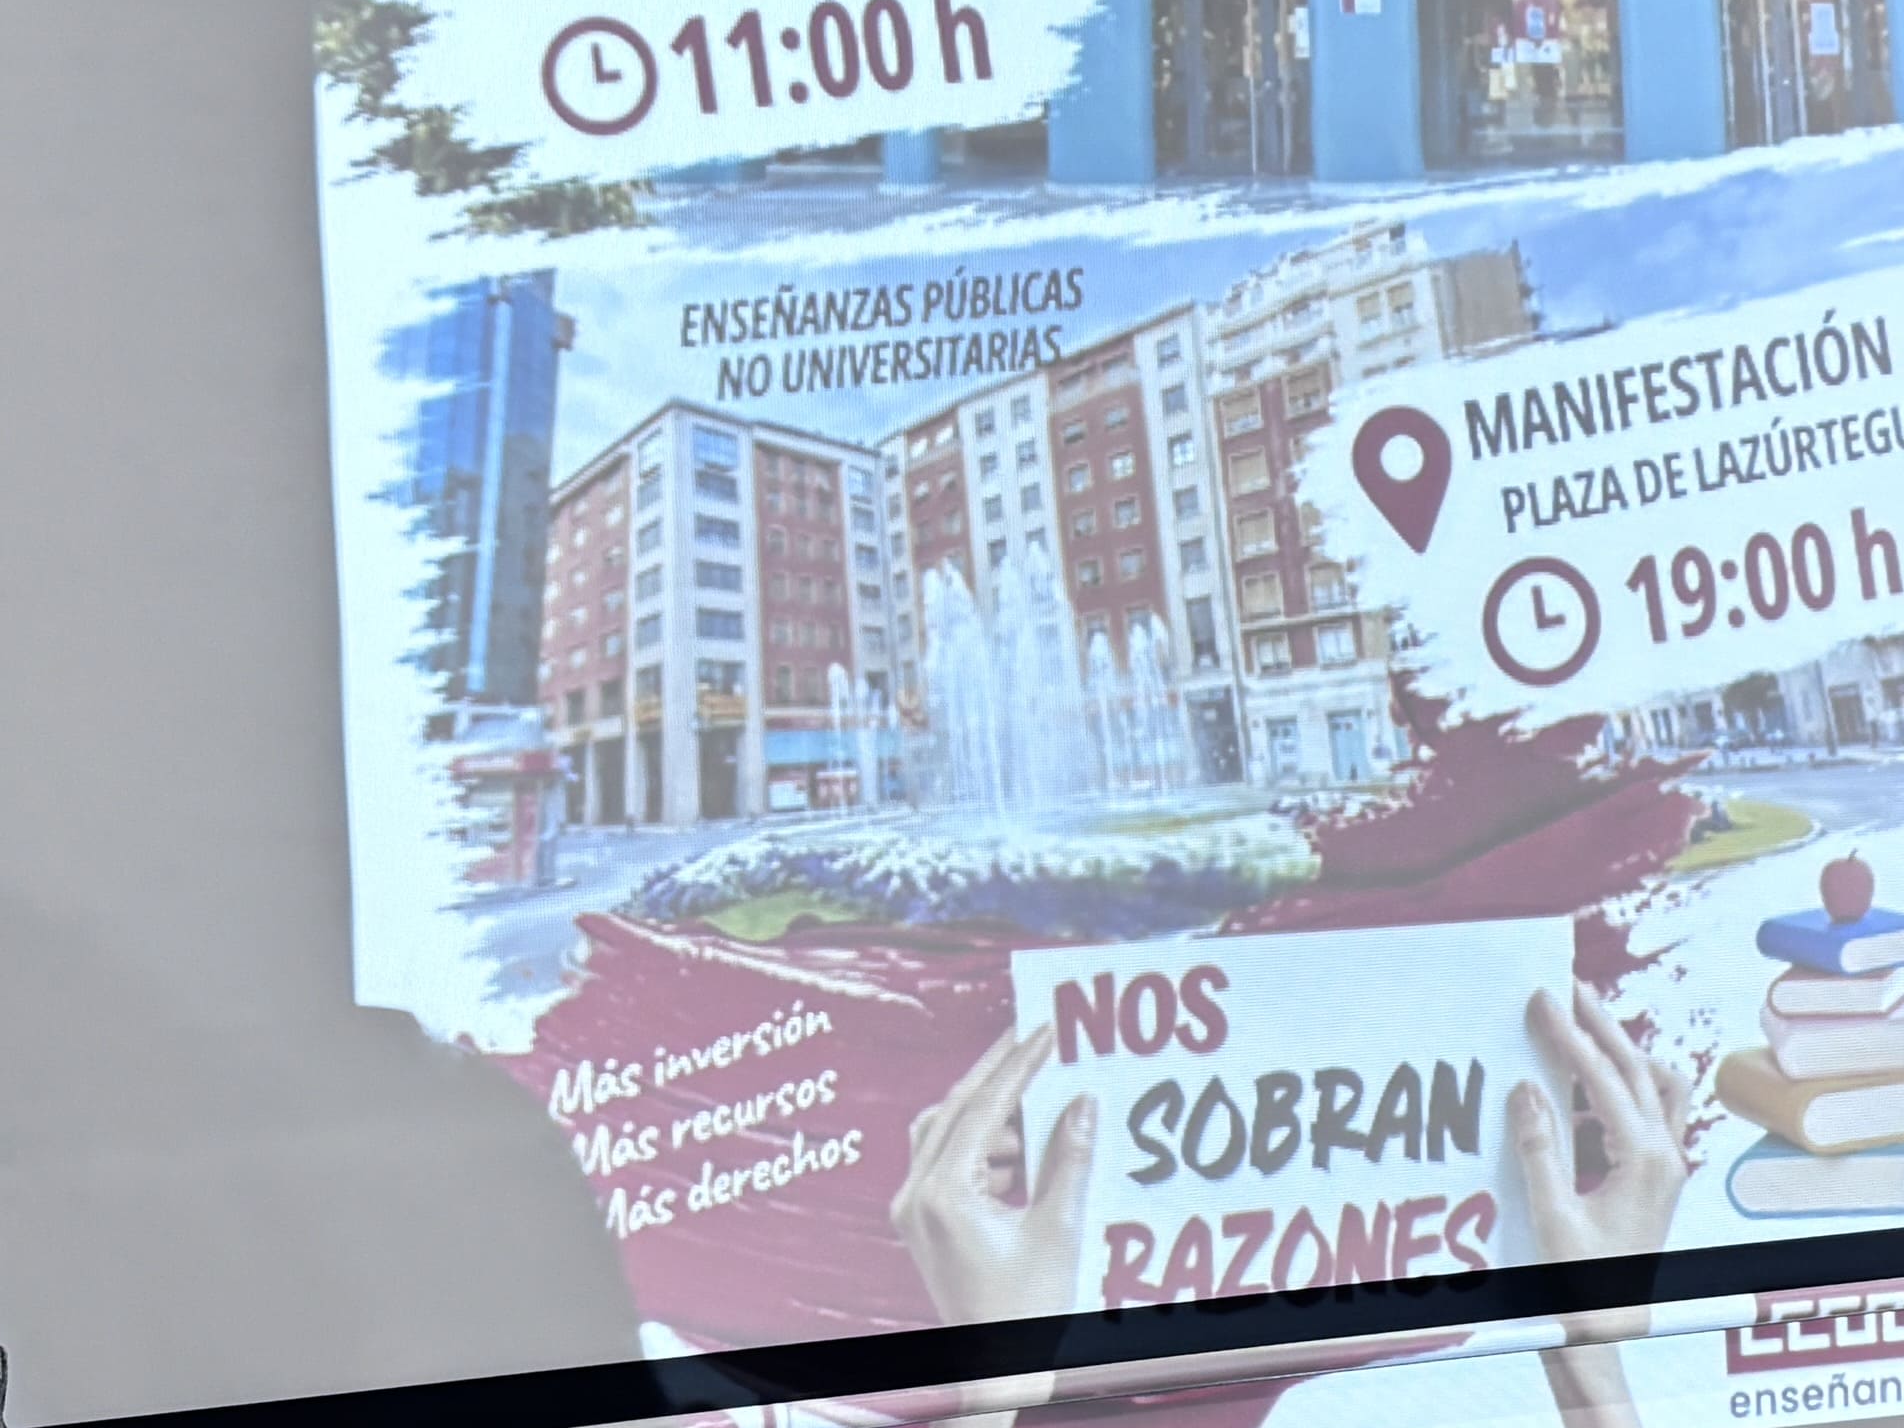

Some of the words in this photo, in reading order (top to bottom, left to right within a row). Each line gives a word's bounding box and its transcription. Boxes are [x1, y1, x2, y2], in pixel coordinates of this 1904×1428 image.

[679, 283, 915, 348] ENSEÑANZAS
[921, 266, 1084, 324] PÚBLICAS
[717, 352, 773, 401] NO
[782, 325, 1063, 393] UNIVERSITARIAS
[1463, 308, 1894, 461] MANIFESTACIÓN
[1500, 466, 1629, 533] PLAZA
[1633, 452, 1688, 506] DE
[1625, 522, 1835, 643] 19:00
[1850, 507, 1904, 601] h
[548, 1058, 643, 1127] Más
[654, 1000, 833, 1088] inversión
[1053, 965, 1229, 1064] NOS
[672, 1070, 838, 1150] recursos
[1126, 1059, 1484, 1184] SOBRAN
[688, 1129, 864, 1213] derechos
[1102, 1191, 1497, 1317] RAZONES
